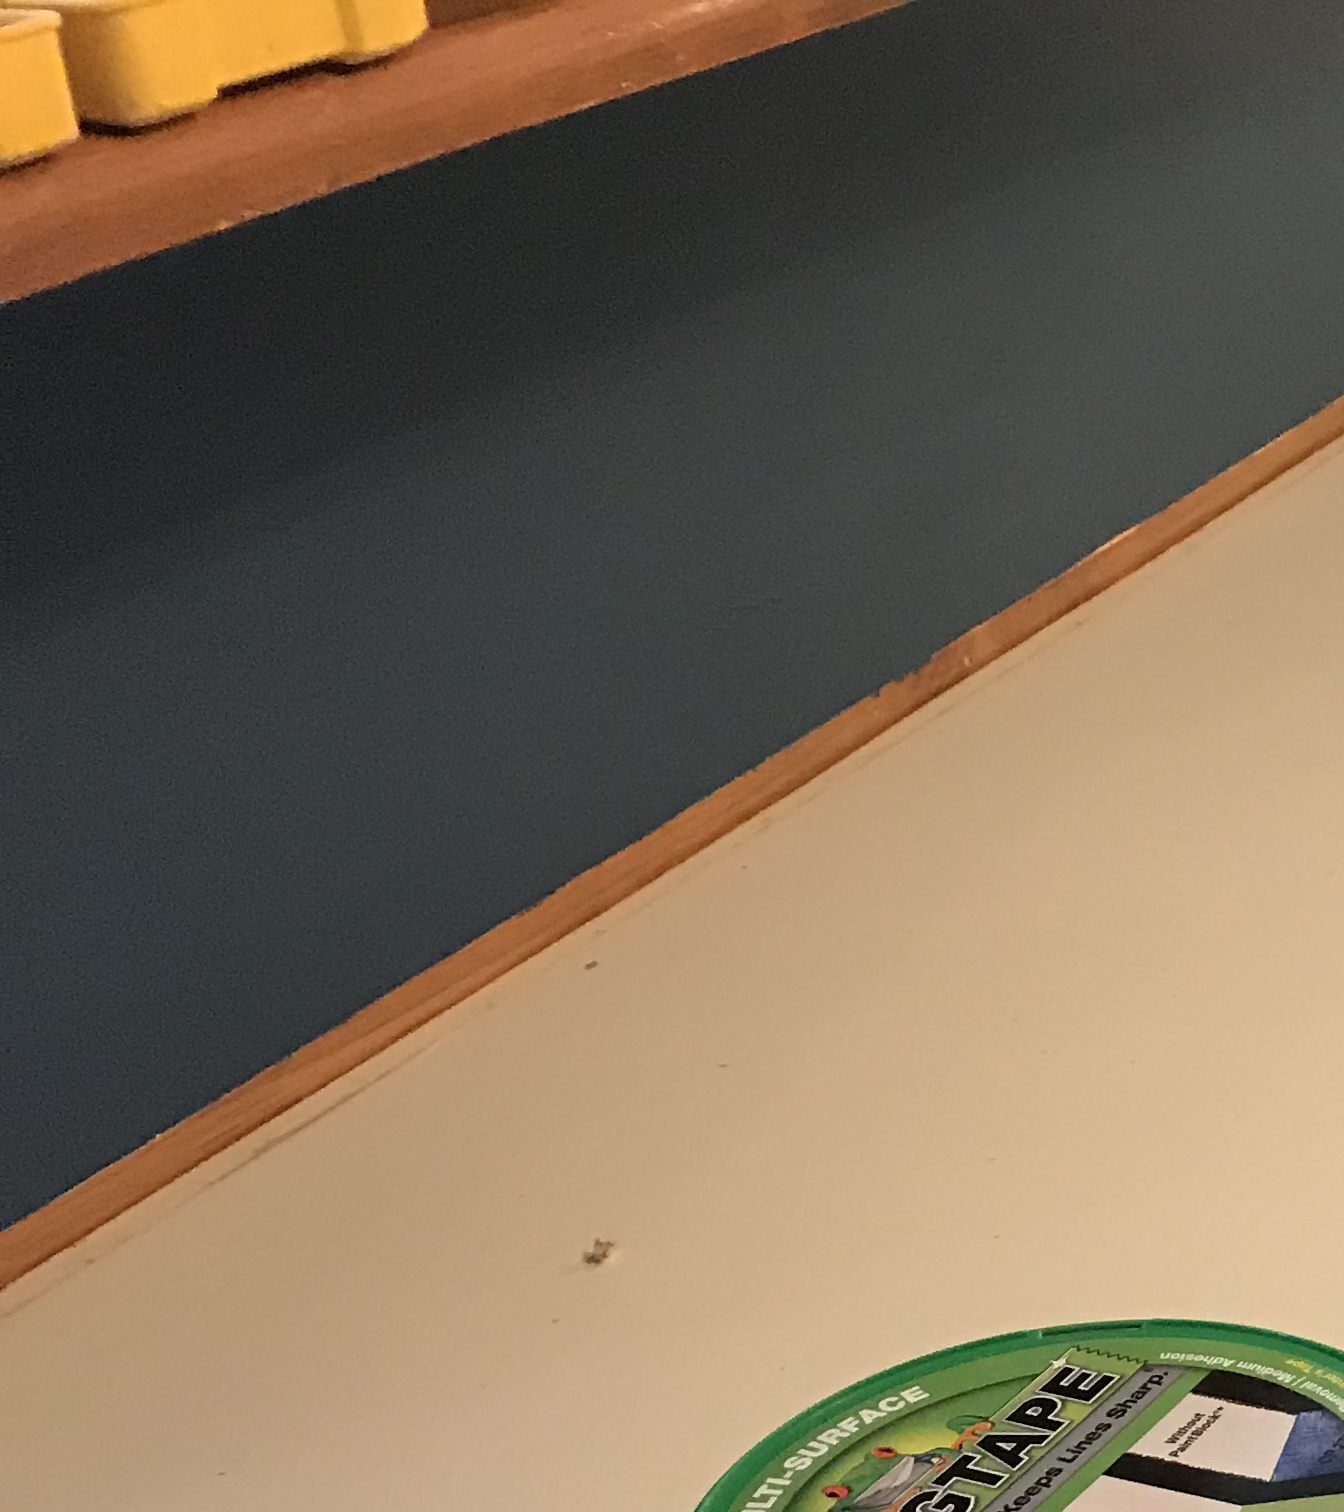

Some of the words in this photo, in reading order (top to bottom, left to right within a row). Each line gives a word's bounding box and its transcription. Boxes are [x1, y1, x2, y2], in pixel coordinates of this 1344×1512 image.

[1160, 1352, 1237, 1367] Adhesion
[1236, 1360, 1296, 1383] Medium
[1058, 1422, 1112, 1464] Lines
[1106, 1370, 1170, 1420] Sharp.
[1164, 1413, 1206, 1443] Without
